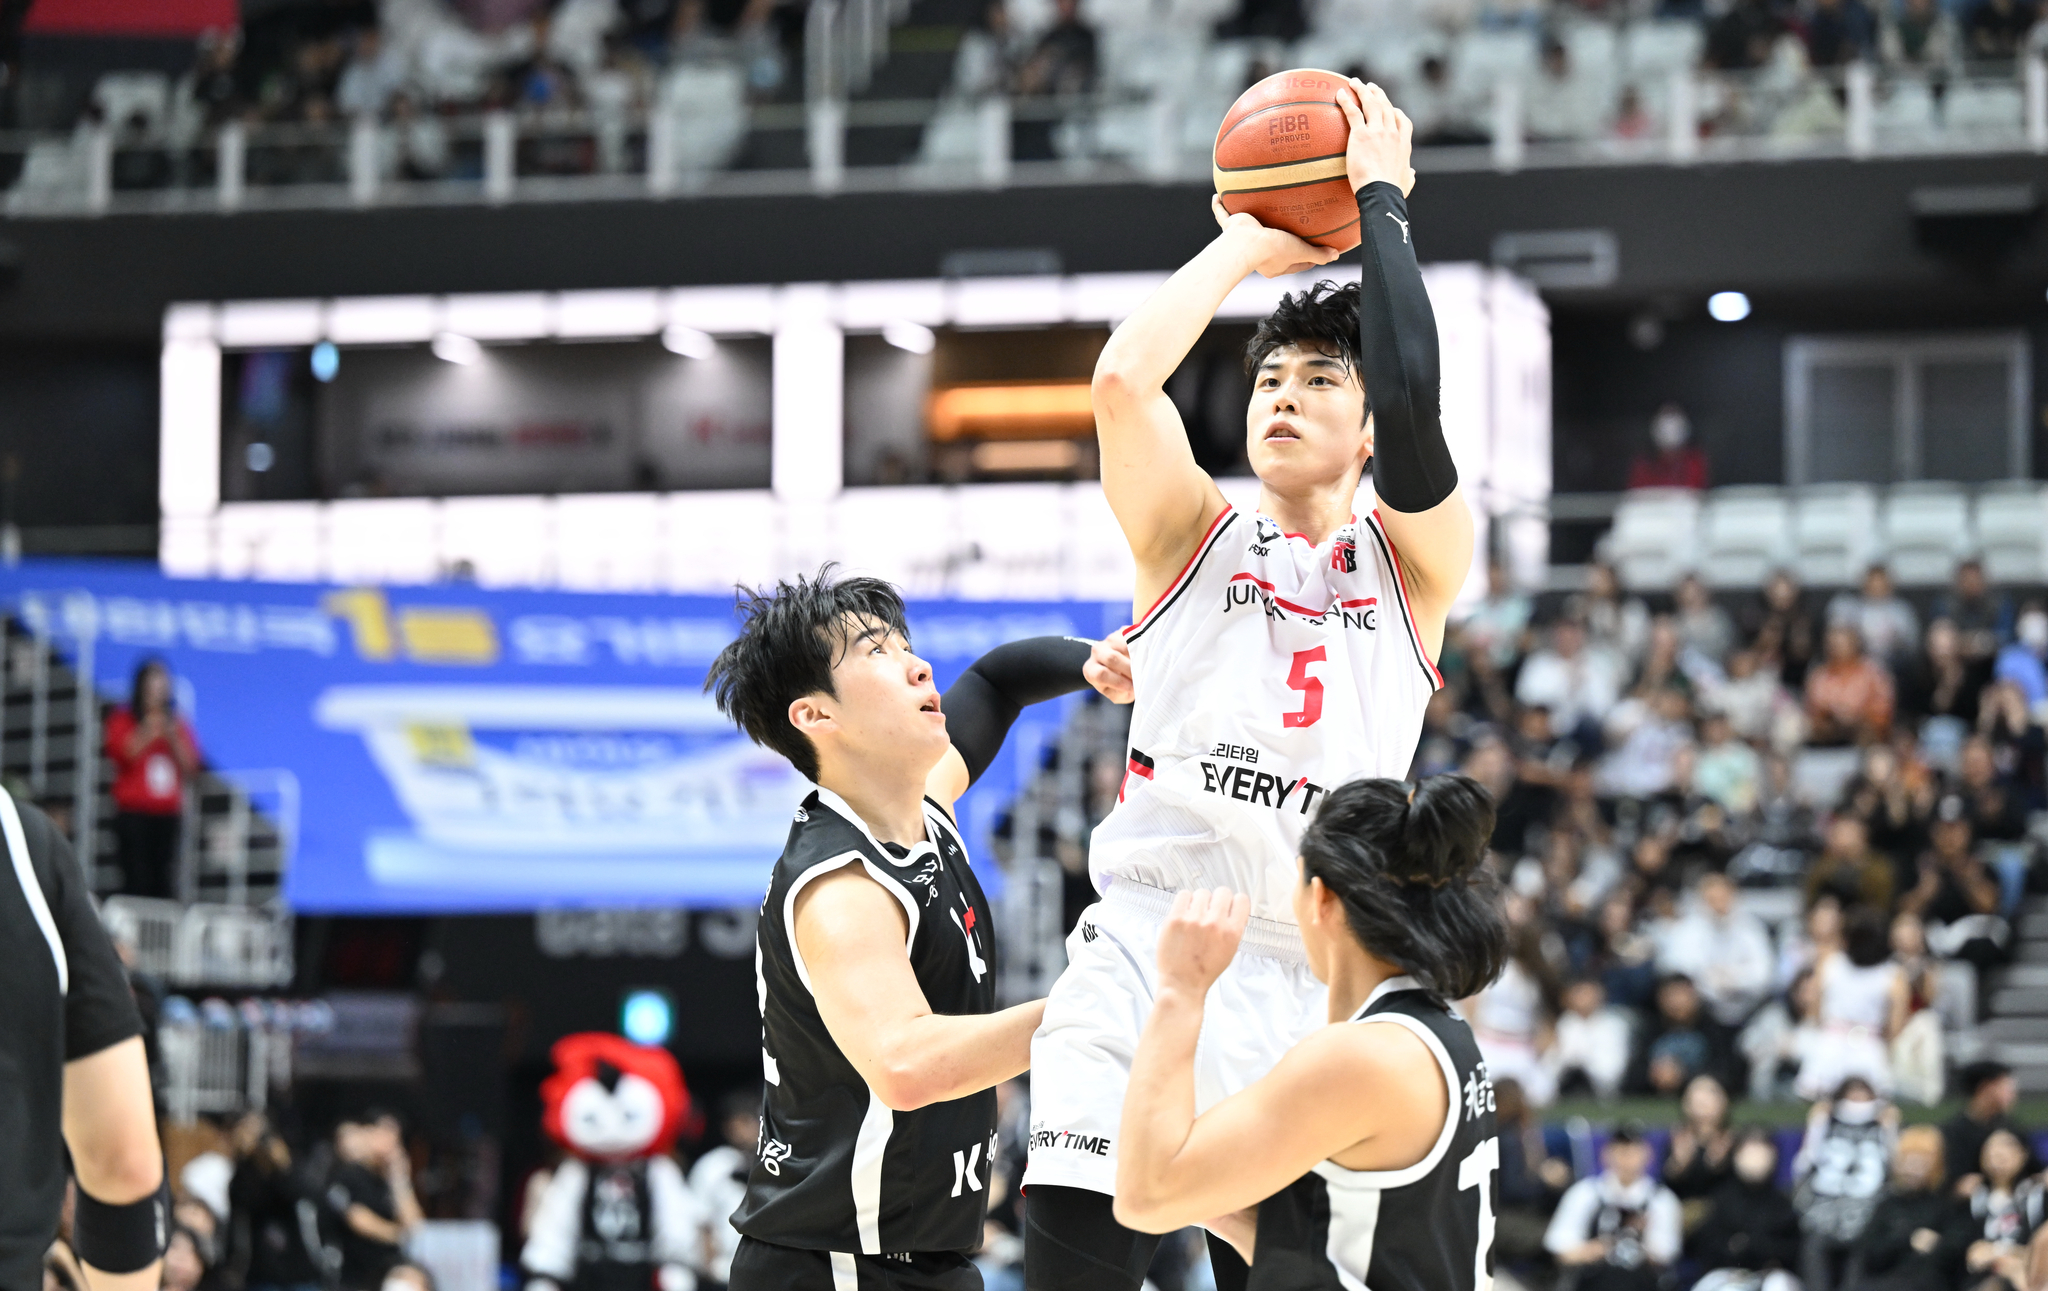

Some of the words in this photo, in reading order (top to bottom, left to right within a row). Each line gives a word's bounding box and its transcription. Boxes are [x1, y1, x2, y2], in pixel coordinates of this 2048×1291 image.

[1269, 114, 1309, 136] FIBA
[1270, 133, 1311, 145] APPROVED
[1282, 645, 1327, 728] 5
[1209, 742, 1259, 764] 리타임
